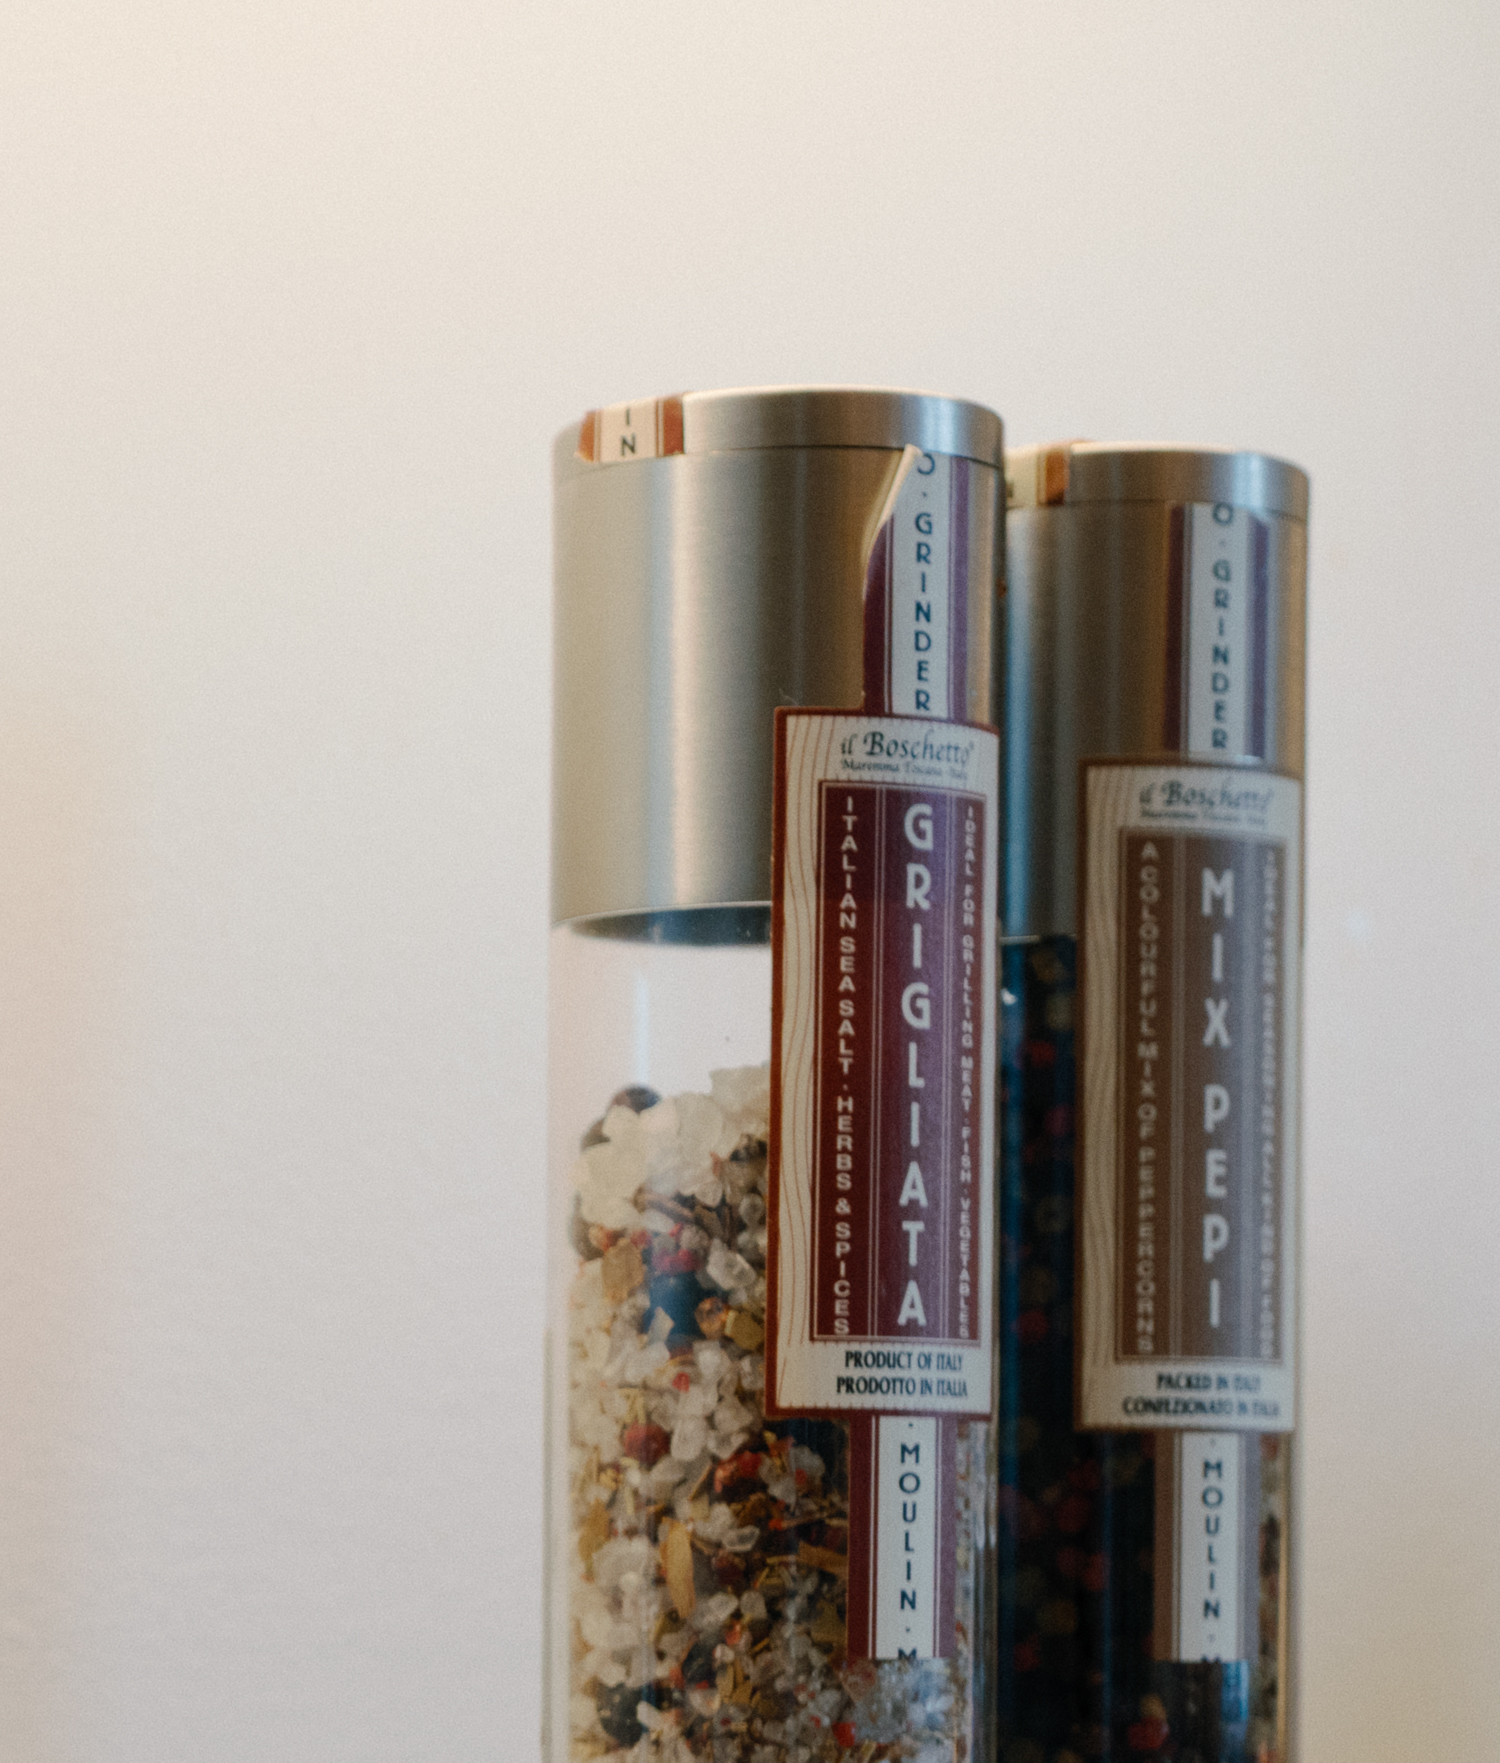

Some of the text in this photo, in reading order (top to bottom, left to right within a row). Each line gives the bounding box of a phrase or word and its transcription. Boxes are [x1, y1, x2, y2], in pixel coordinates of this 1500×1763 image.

[915, 513, 932, 710] GRINDER
[1212, 560, 1231, 748] GRINDER
[863, 729, 971, 764] Boschetto
[964, 805, 976, 877] IDEAL
[834, 796, 858, 1335] ITALIAN SEA SALT HERBS & SPICES
[898, 803, 934, 1327] GRIGLIATA
[961, 935, 974, 1049] GRILLING
[960, 1056, 973, 1113] MEAT
[1202, 867, 1235, 1328] MIX PEPI
[959, 1197, 971, 1339] VEGETABLES
[837, 1376, 967, 1397] PRODOTTO IN ITALIA
[845, 1351, 962, 1371] PRODUCT OF ITALY
[899, 1443, 921, 1610] MOULIN
[1202, 1459, 1224, 1619] MOULIN
